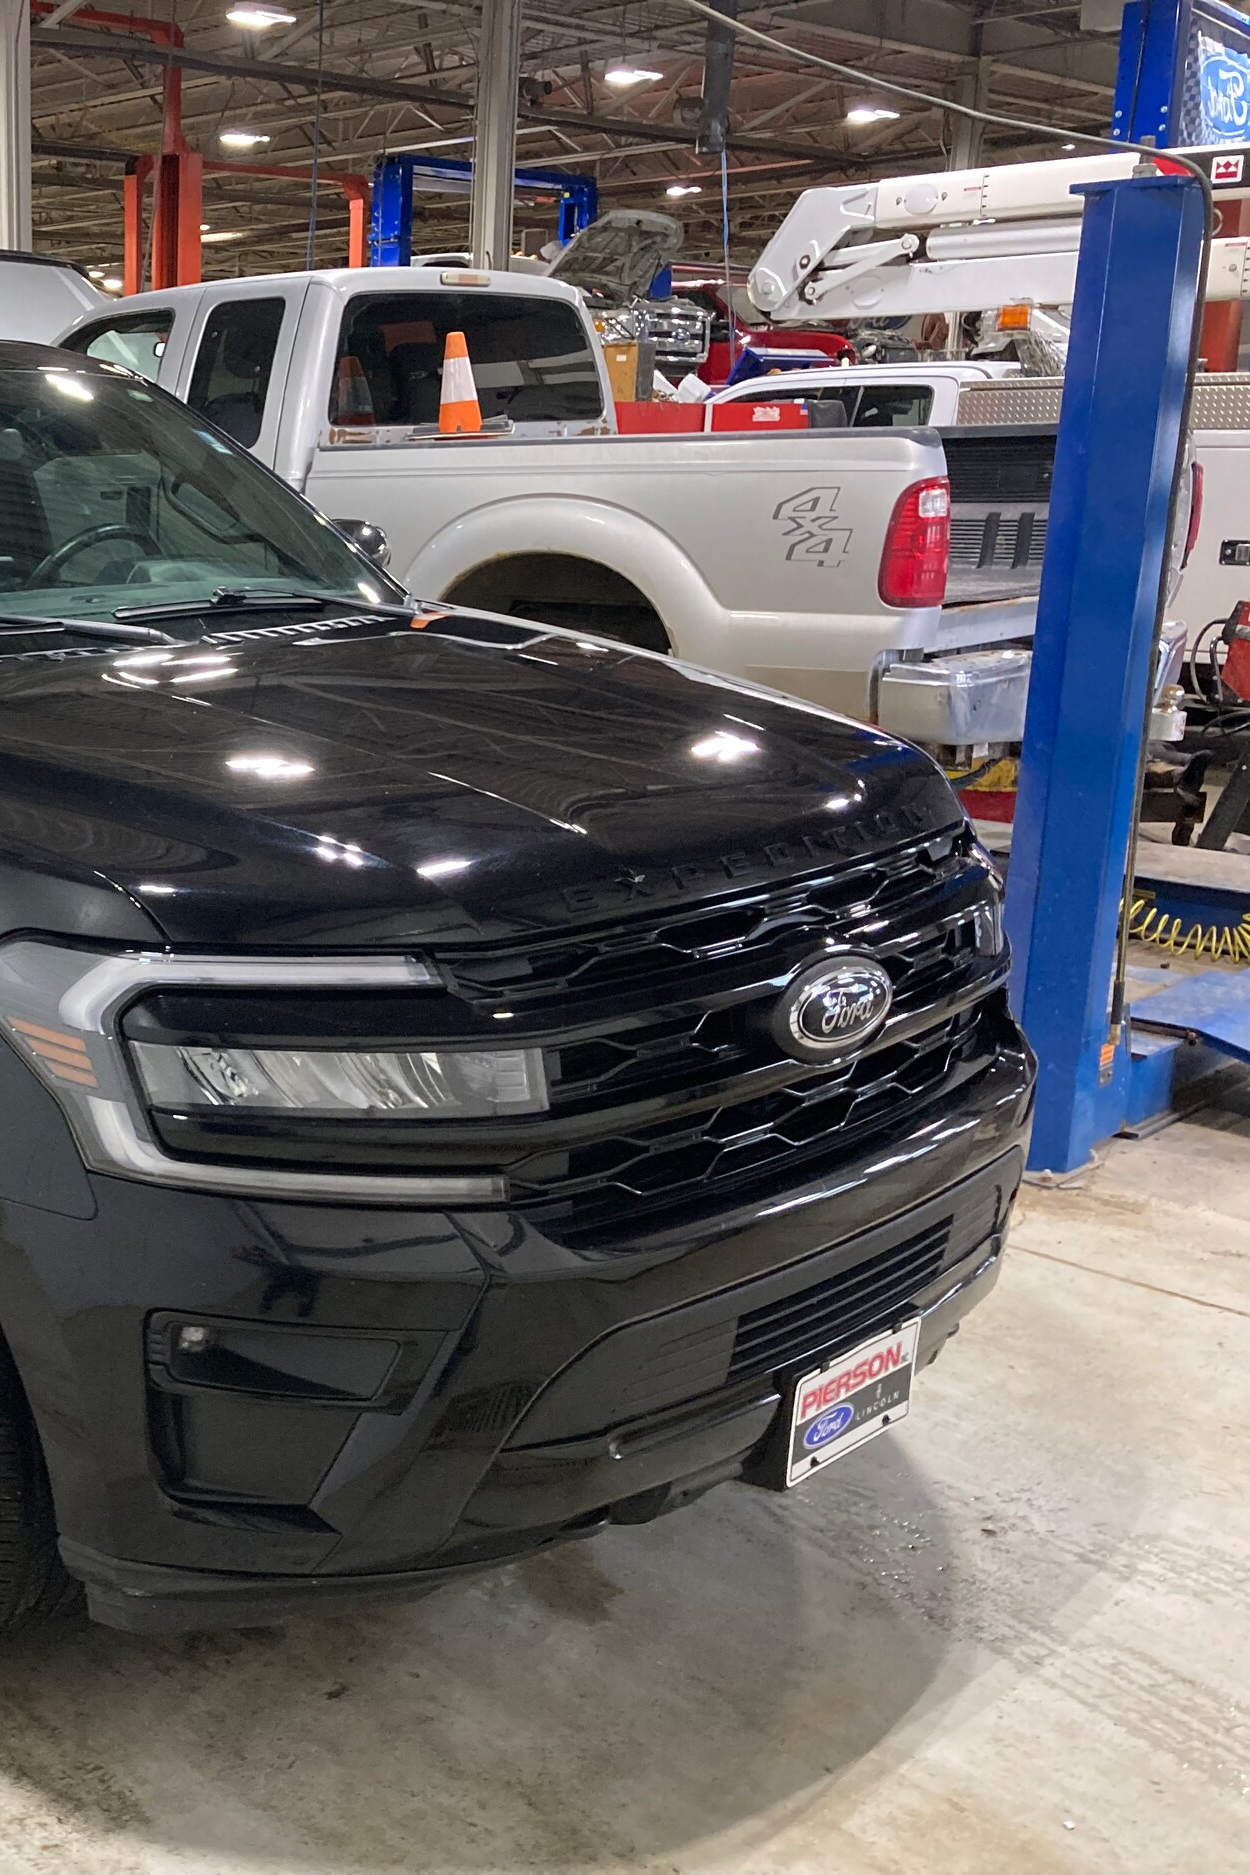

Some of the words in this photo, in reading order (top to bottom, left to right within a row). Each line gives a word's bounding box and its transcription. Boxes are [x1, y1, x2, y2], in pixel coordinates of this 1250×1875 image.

[561, 803, 934, 913] EXPEDITION
[822, 983, 875, 1034] Ford
[800, 1341, 903, 1419] PIERSON
[854, 1390, 901, 1421] LINCOLN
[813, 1411, 846, 1442] Ford
